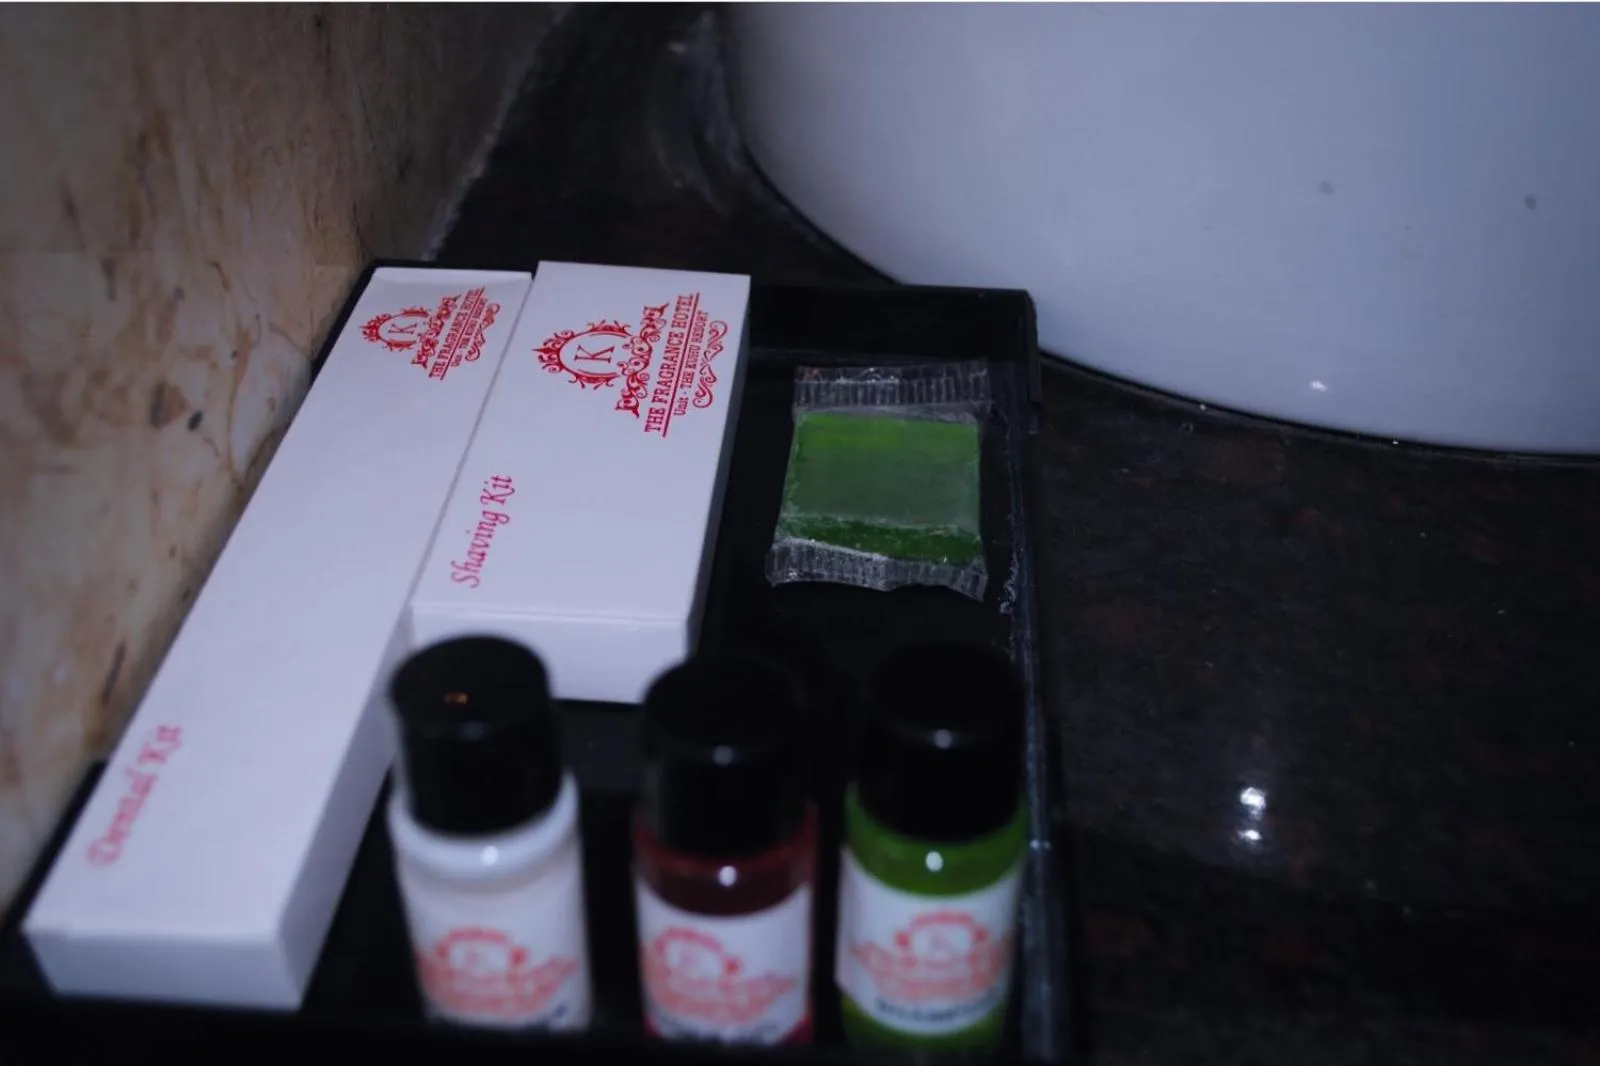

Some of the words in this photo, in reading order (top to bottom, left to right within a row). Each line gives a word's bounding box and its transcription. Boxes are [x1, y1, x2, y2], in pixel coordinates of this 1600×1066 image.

[671, 293, 694, 329] HOTEL
[691, 310, 709, 343] RESORT
[574, 344, 615, 364] K
[651, 331, 684, 403] FRAGRANCE
[679, 372, 695, 389] THE
[644, 407, 665, 433] THE
[673, 397, 689, 416] Unit
[479, 475, 515, 505] Kit
[450, 510, 511, 589] Shaving
